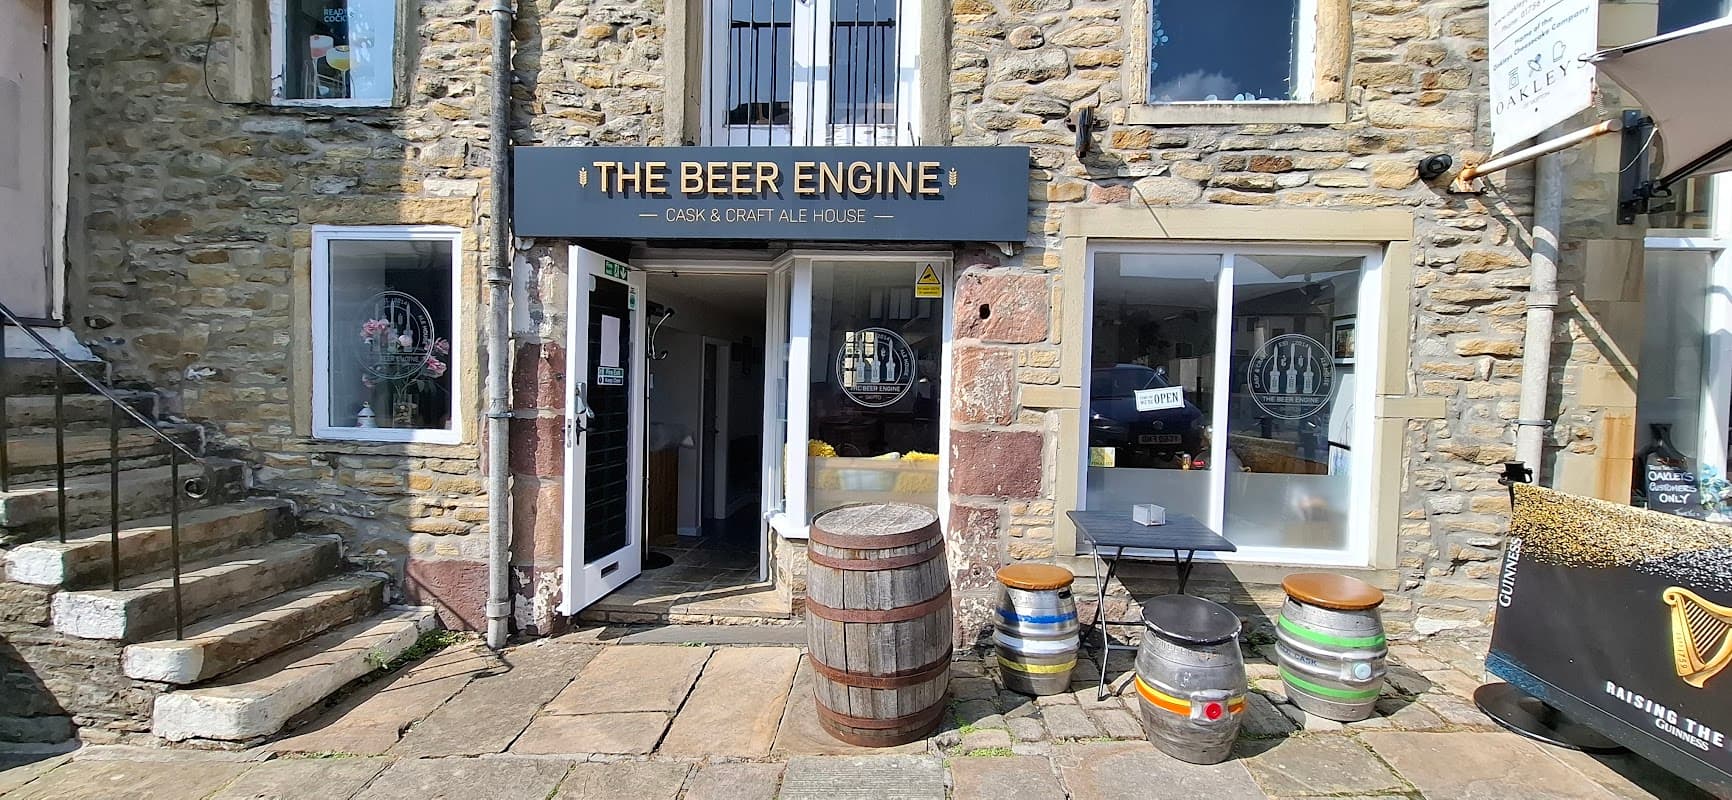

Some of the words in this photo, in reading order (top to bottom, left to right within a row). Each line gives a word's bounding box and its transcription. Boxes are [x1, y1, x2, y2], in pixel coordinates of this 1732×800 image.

[1551, 6, 1590, 30] Company
[1496, 53, 1588, 115] OAKLEYS
[593, 161, 667, 193] THE
[680, 161, 780, 193] BEER
[793, 161, 941, 194] ENGINE
[665, 208, 706, 223] CASK
[710, 208, 721, 223] &
[725, 208, 775, 223] CRAFT
[778, 208, 808, 223] ALE
[813, 208, 867, 223] HOUSE
[880, 385, 901, 393] ENGINE
[1154, 392, 1178, 404] OPEN
[1295, 396, 1320, 404] ENGINE
[1659, 493, 1690, 504] ONLY
[1499, 537, 1522, 607] GUINNESS
[1606, 681, 1678, 725] RAISING
[1685, 718, 1725, 748] THE
[1655, 718, 1710, 751] GUINNESS
